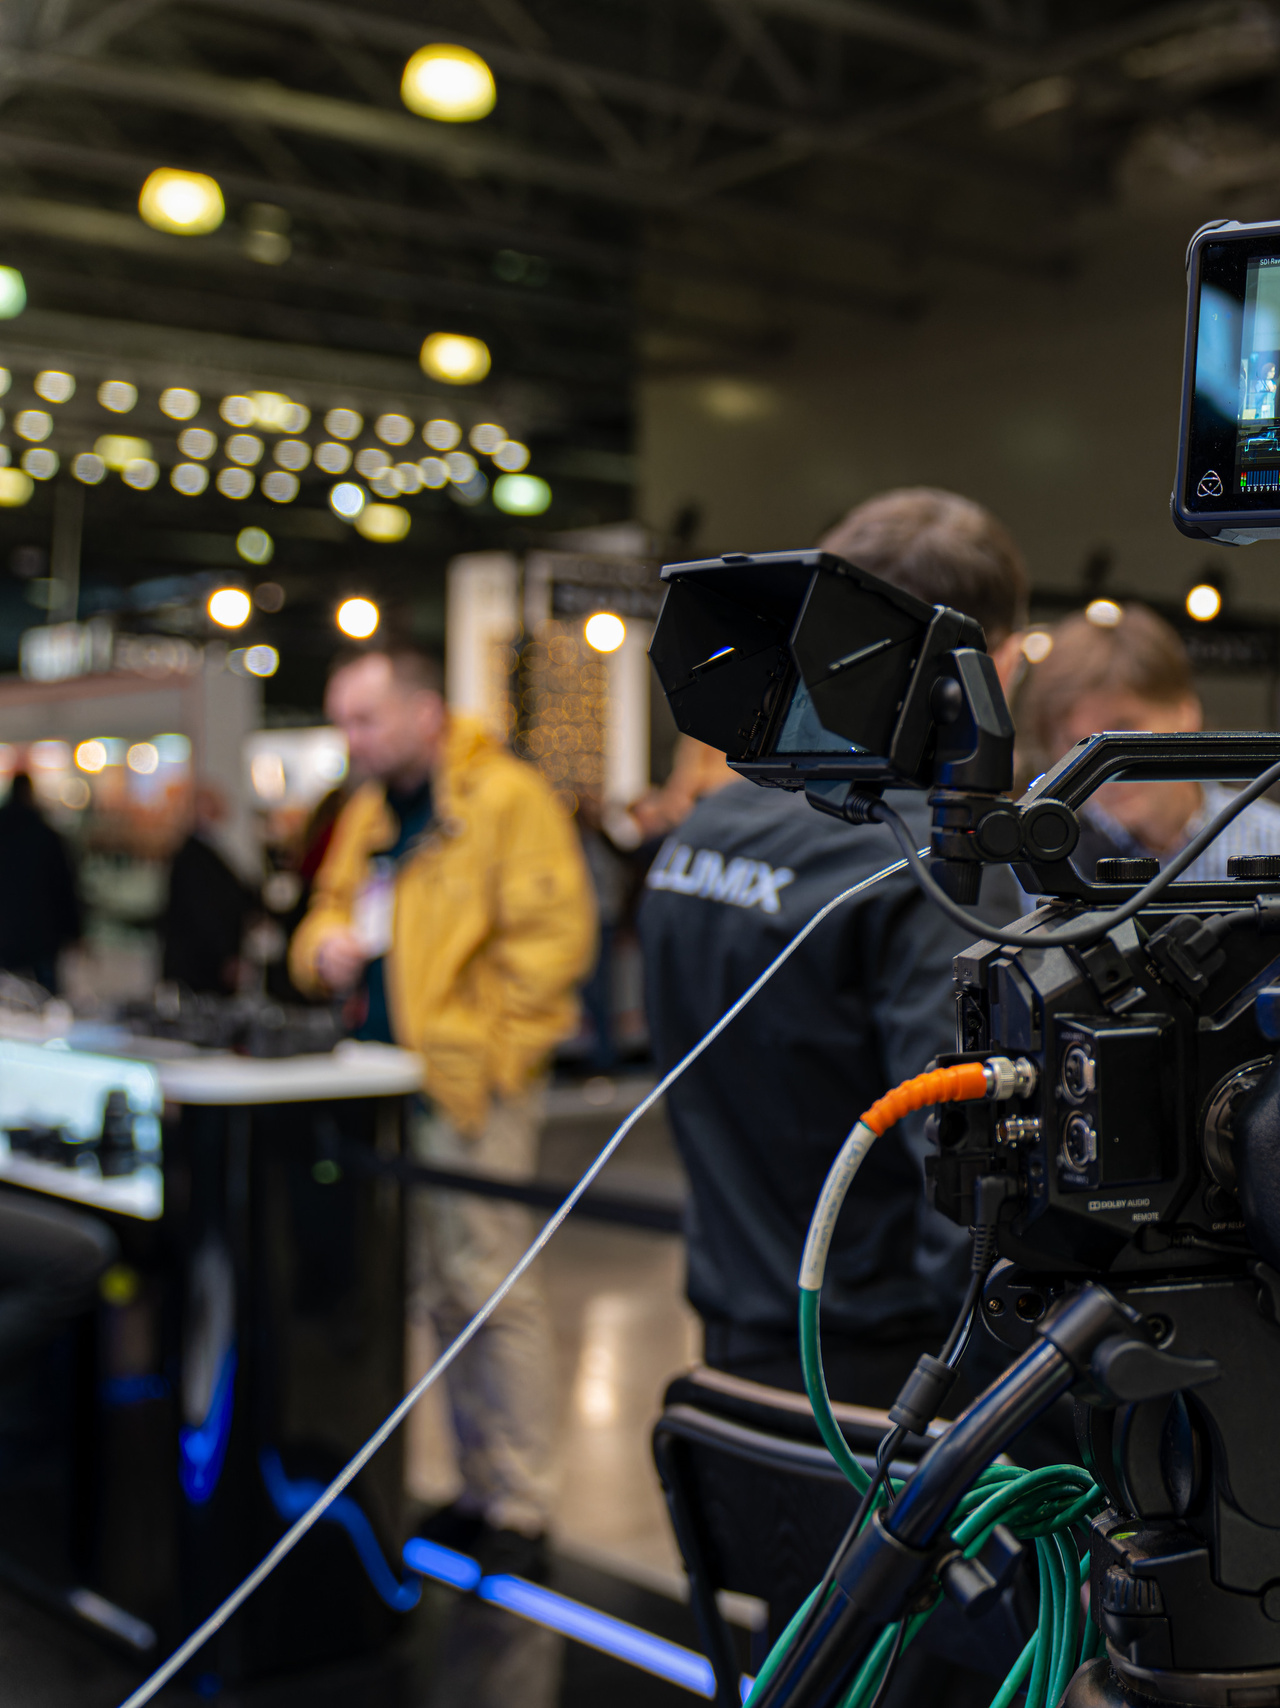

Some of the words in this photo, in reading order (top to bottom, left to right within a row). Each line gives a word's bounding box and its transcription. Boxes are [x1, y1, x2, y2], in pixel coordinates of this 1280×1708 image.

[646, 837, 797, 915] LUMIX
[1101, 1201, 1127, 1210] DOLBY
[1127, 1198, 1151, 1208] AUDIO
[1132, 1212, 1160, 1222] REMOTE
